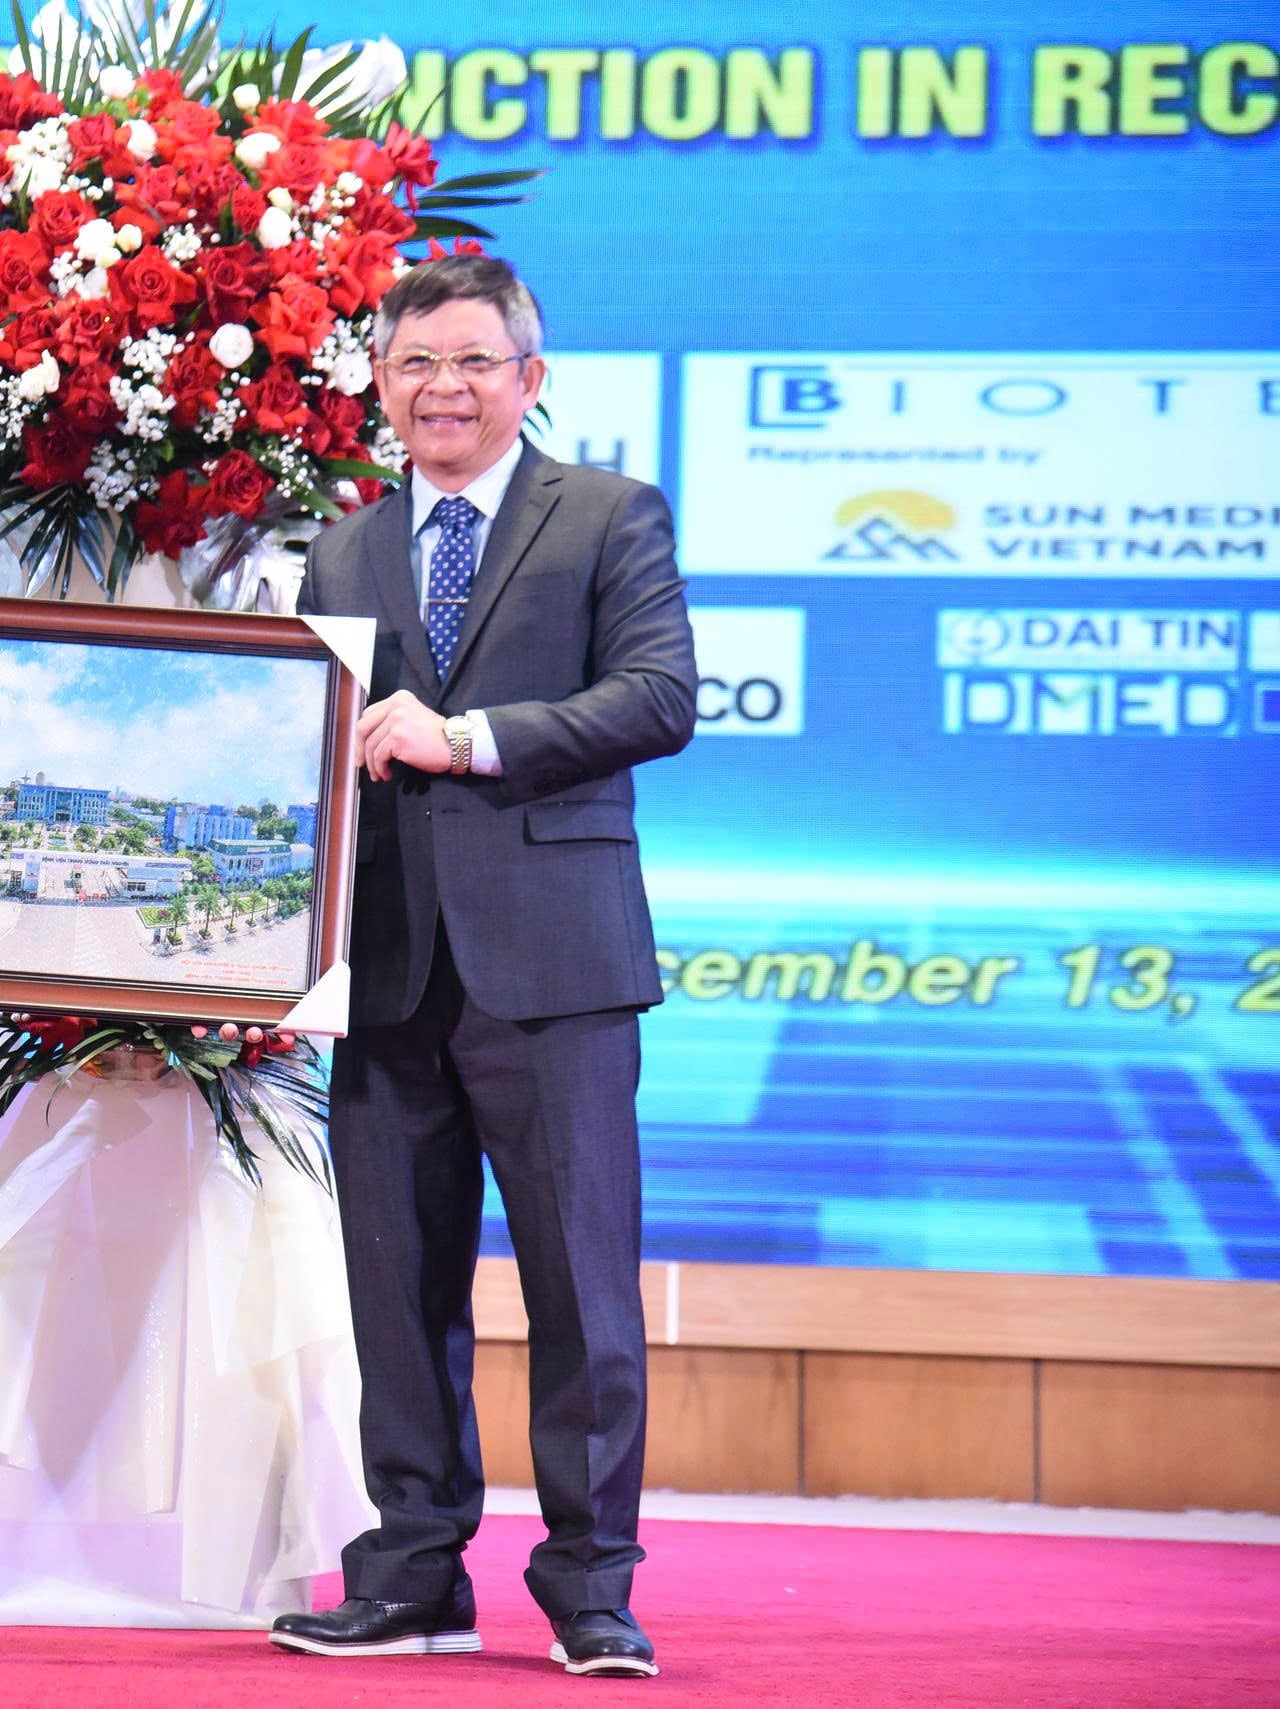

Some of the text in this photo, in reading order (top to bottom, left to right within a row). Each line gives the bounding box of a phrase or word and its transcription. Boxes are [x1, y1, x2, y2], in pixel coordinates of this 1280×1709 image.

[856, 47, 987, 137] IN
[747, 445, 1044, 466] Represented by
[984, 506, 1104, 528] SUN
[984, 540, 1266, 560] VIETNAM
[1024, 619, 1234, 647] DAI TIN
[1061, 946, 1197, 1017] 13,
